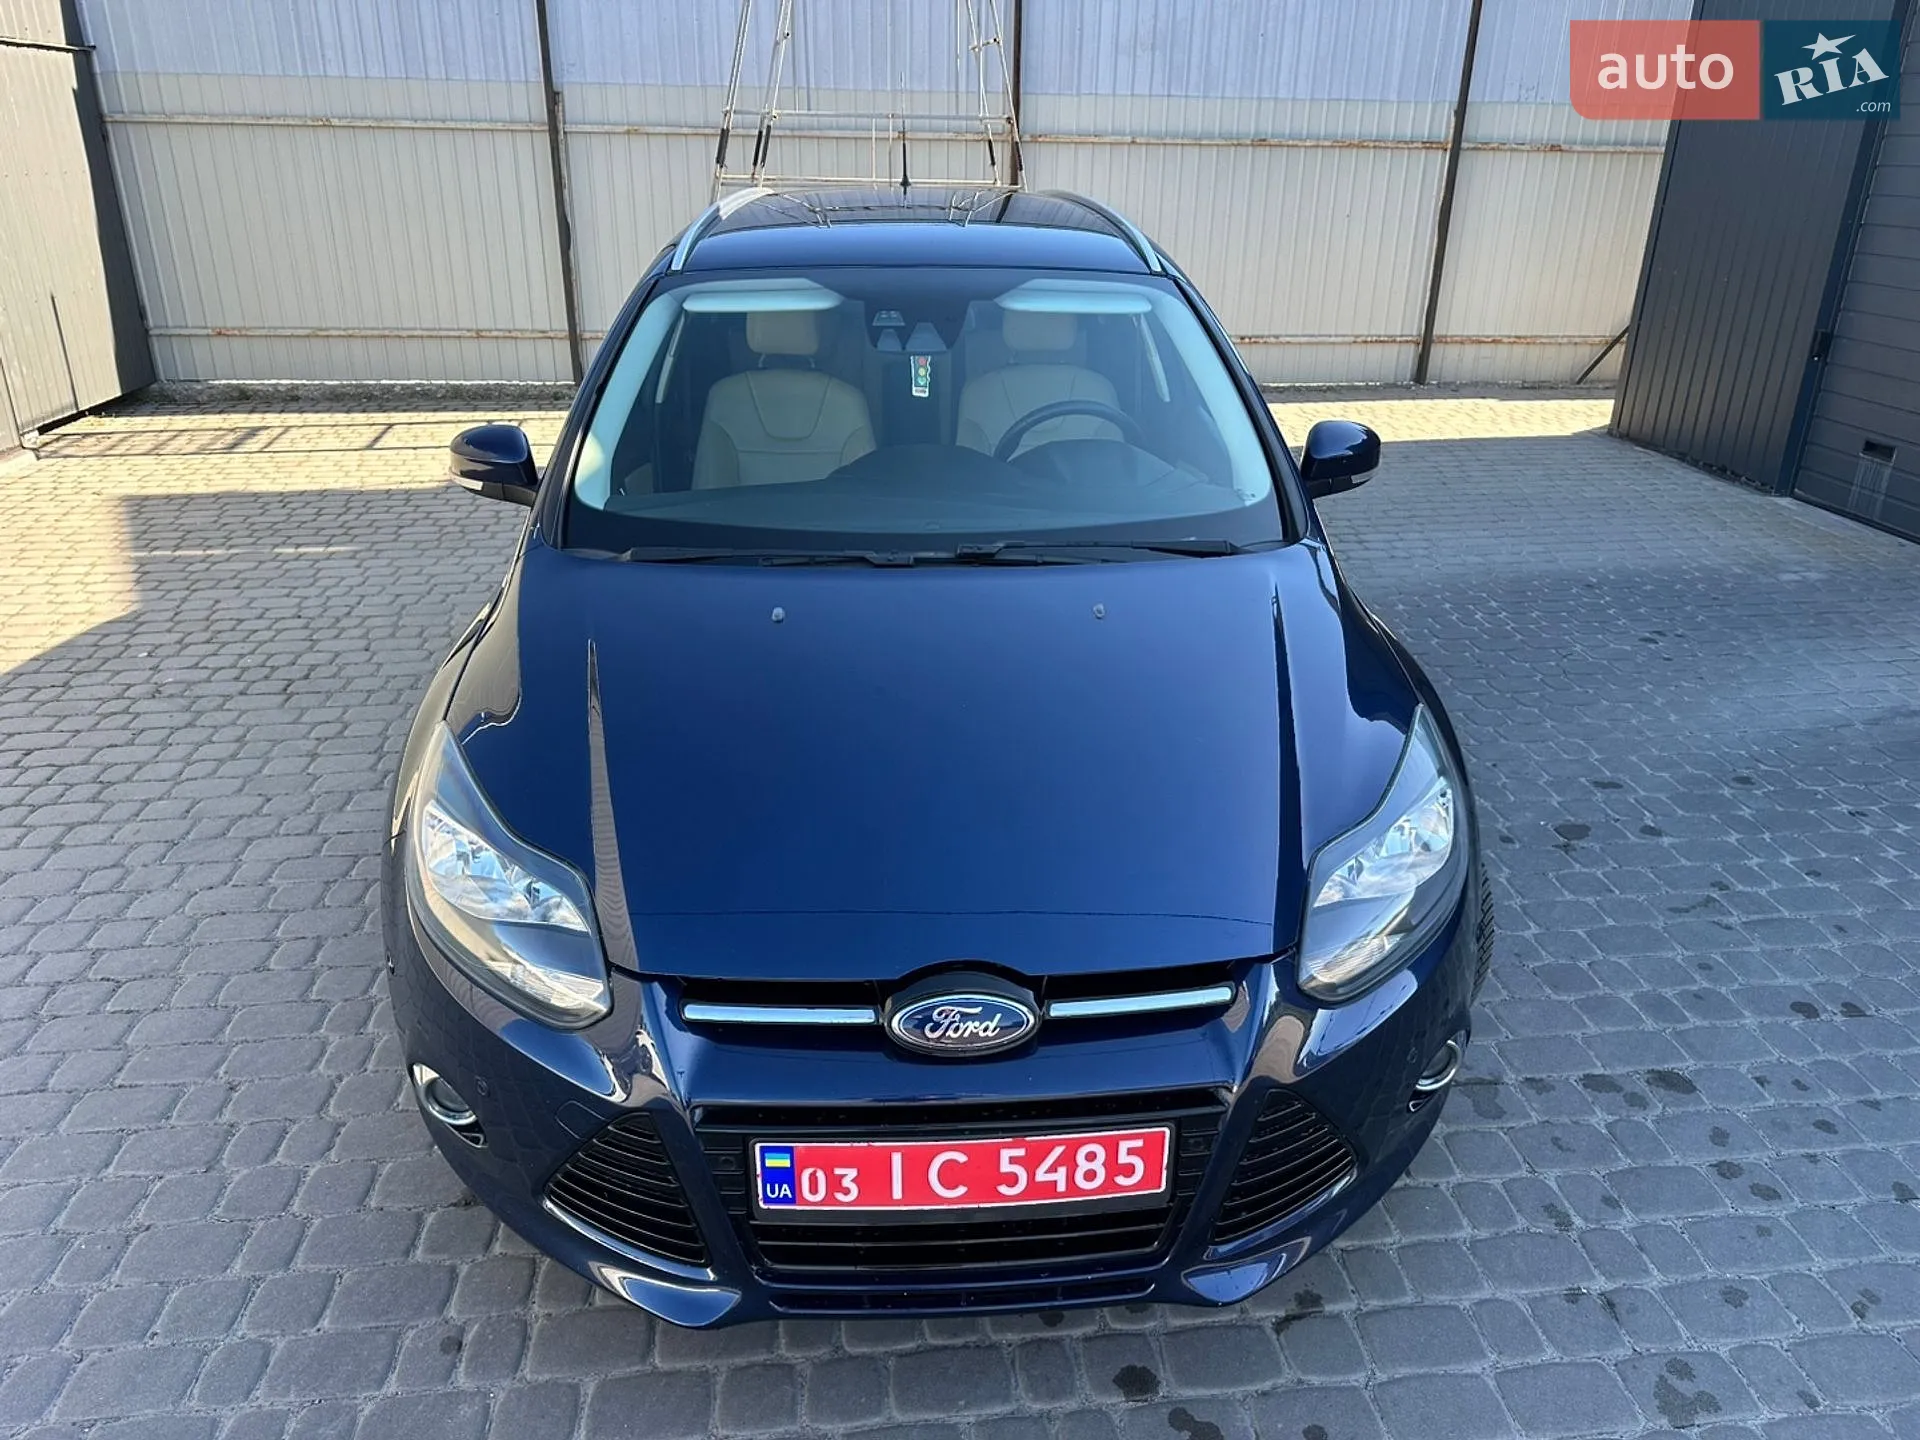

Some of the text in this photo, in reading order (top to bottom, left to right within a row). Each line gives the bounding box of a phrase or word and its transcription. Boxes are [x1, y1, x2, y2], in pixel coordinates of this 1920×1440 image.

[924, 1006, 1002, 1039] Ford
[801, 1167, 860, 1203] 03
[995, 1138, 1145, 1197] 5485
[766, 1182, 793, 1199] UA
